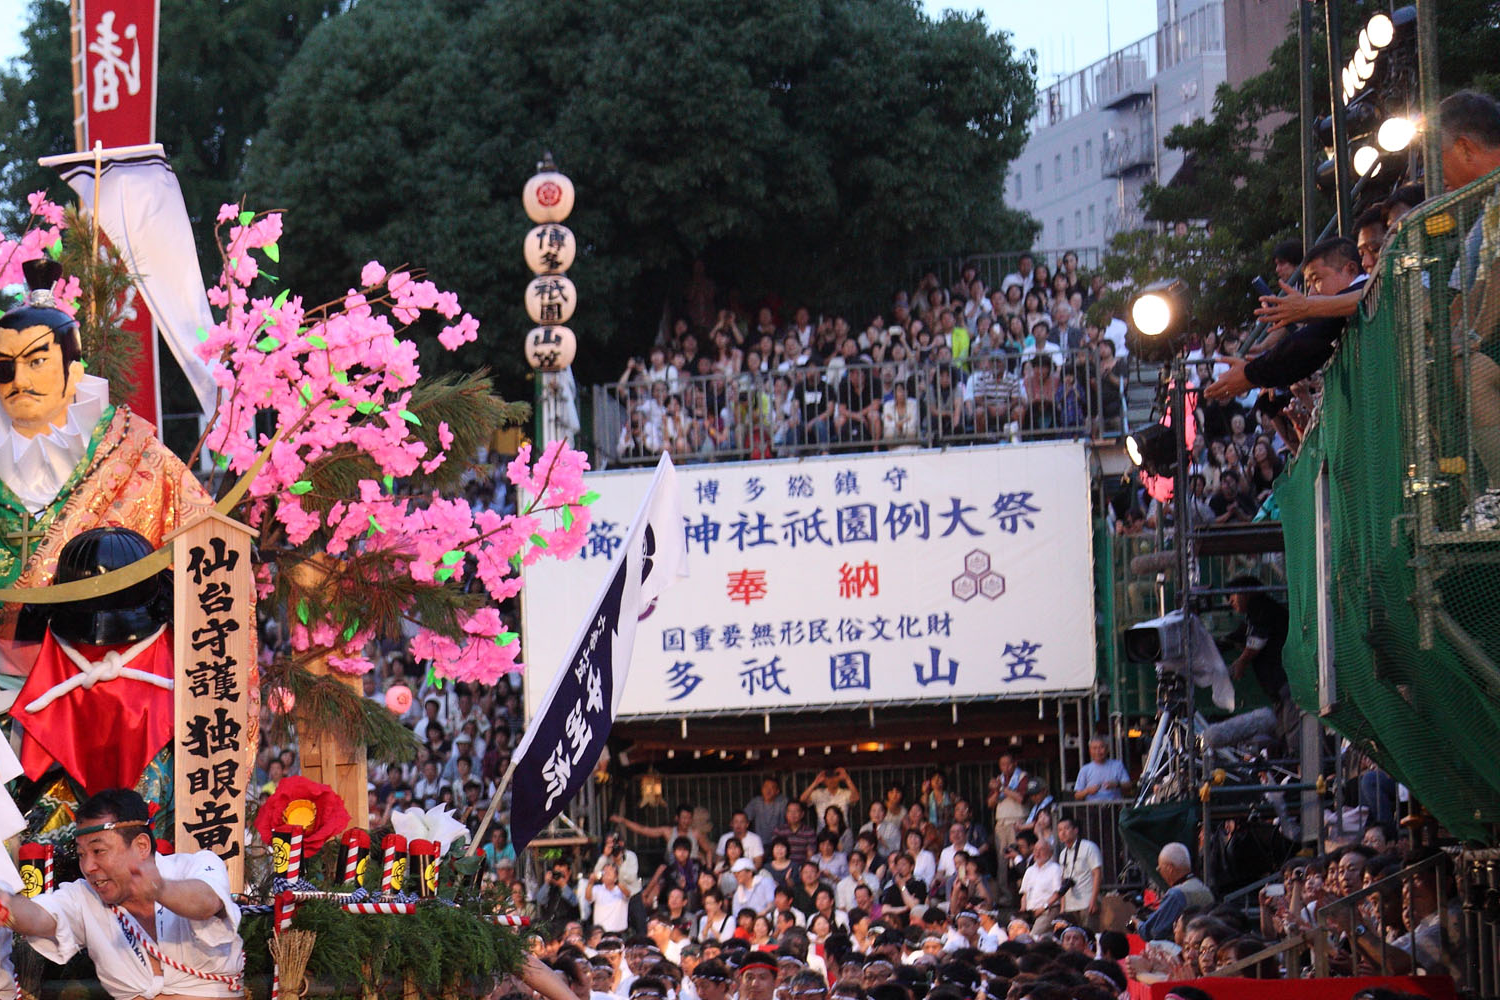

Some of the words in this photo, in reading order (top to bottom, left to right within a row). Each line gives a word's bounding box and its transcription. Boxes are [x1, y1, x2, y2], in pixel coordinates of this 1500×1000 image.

[694, 466, 909, 505] 博多総鎮守
[579, 490, 1042, 562] 櫛神社祇園例大祭
[726, 560, 880, 606] 奉納
[661, 611, 954, 653] 国重要無形民俗文化財
[182, 537, 242, 862] 仙台守護独眼竜
